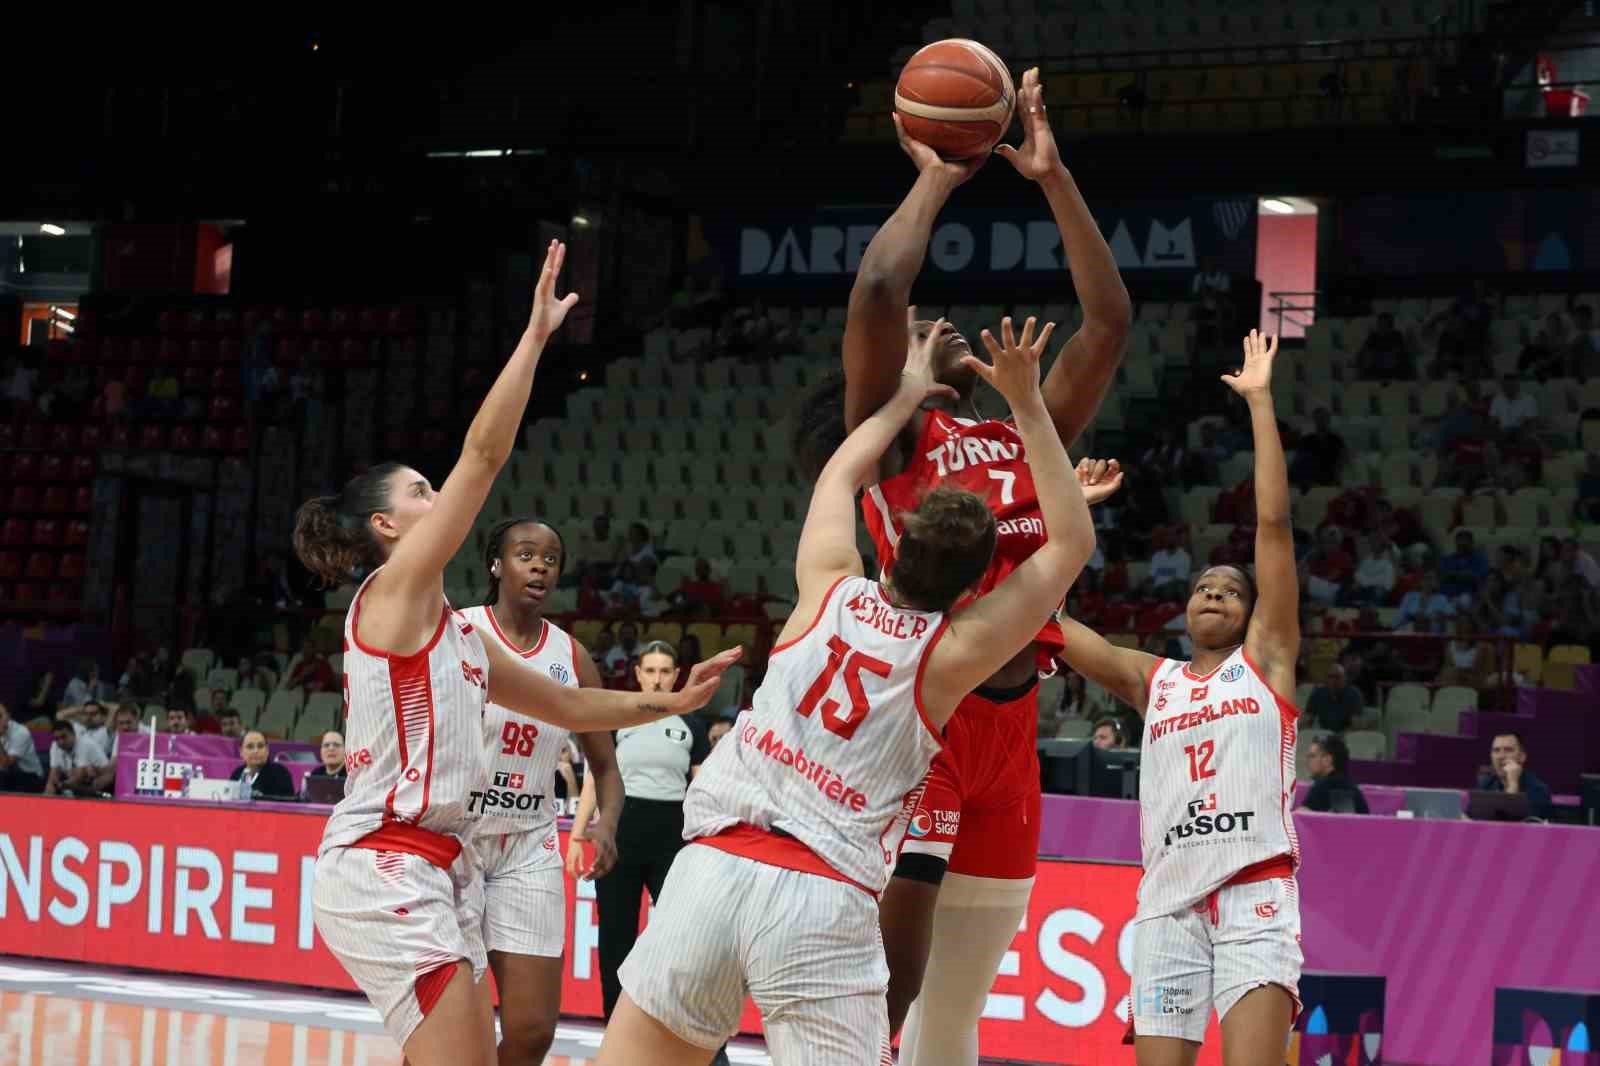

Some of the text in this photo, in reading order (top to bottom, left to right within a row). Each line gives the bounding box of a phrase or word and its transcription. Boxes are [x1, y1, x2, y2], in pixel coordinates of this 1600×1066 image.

[989, 216, 1198, 272] DRAM
[987, 468, 1017, 505] 7
[795, 634, 894, 741] 15
[501, 720, 539, 757] 98
[1150, 697, 1261, 744] WITZERLAND
[757, 728, 868, 812] Mobilière
[1184, 739, 1217, 783] 12
